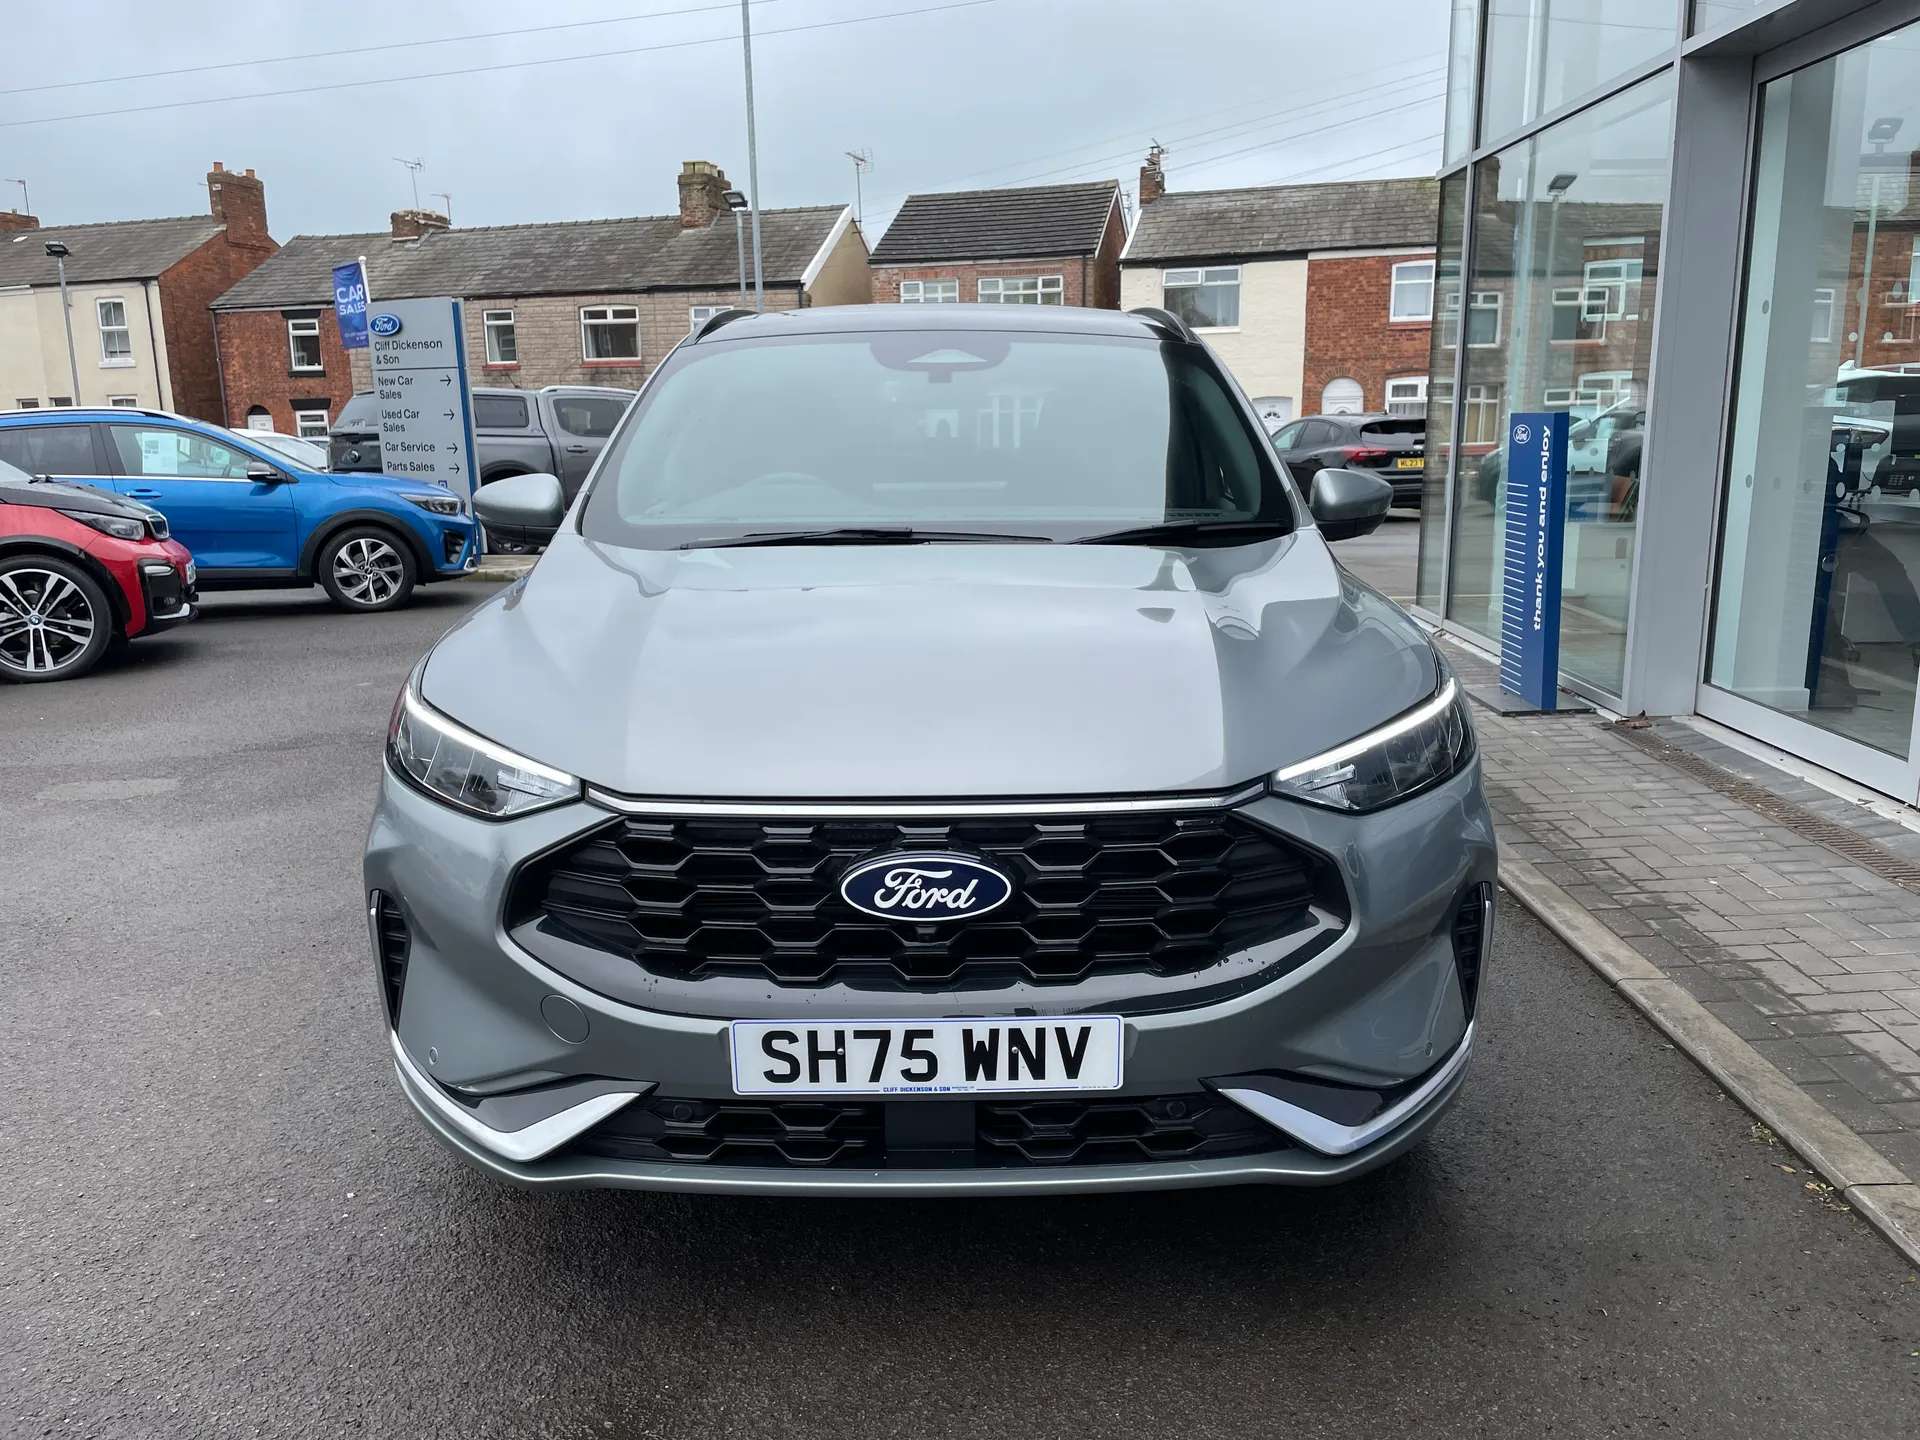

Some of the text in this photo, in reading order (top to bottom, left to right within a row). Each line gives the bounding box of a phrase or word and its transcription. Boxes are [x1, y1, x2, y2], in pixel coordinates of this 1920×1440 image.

[336, 284, 364, 303] CAR
[339, 301, 366, 315] SALES
[374, 317, 393, 331] Ford
[374, 340, 443, 351] Cliff Dickenson
[376, 354, 400, 365] & Son
[378, 375, 414, 386] New Car
[379, 389, 402, 399] Sales
[381, 408, 420, 419] Used Car
[383, 422, 406, 432] Sales
[385, 442, 436, 452] Car Service
[387, 461, 435, 471] Parts Sales
[1534, 425, 1551, 631] thank you and enjoy
[873, 868, 979, 909] Ford
[761, 1026, 1092, 1084] SH75 WNV
